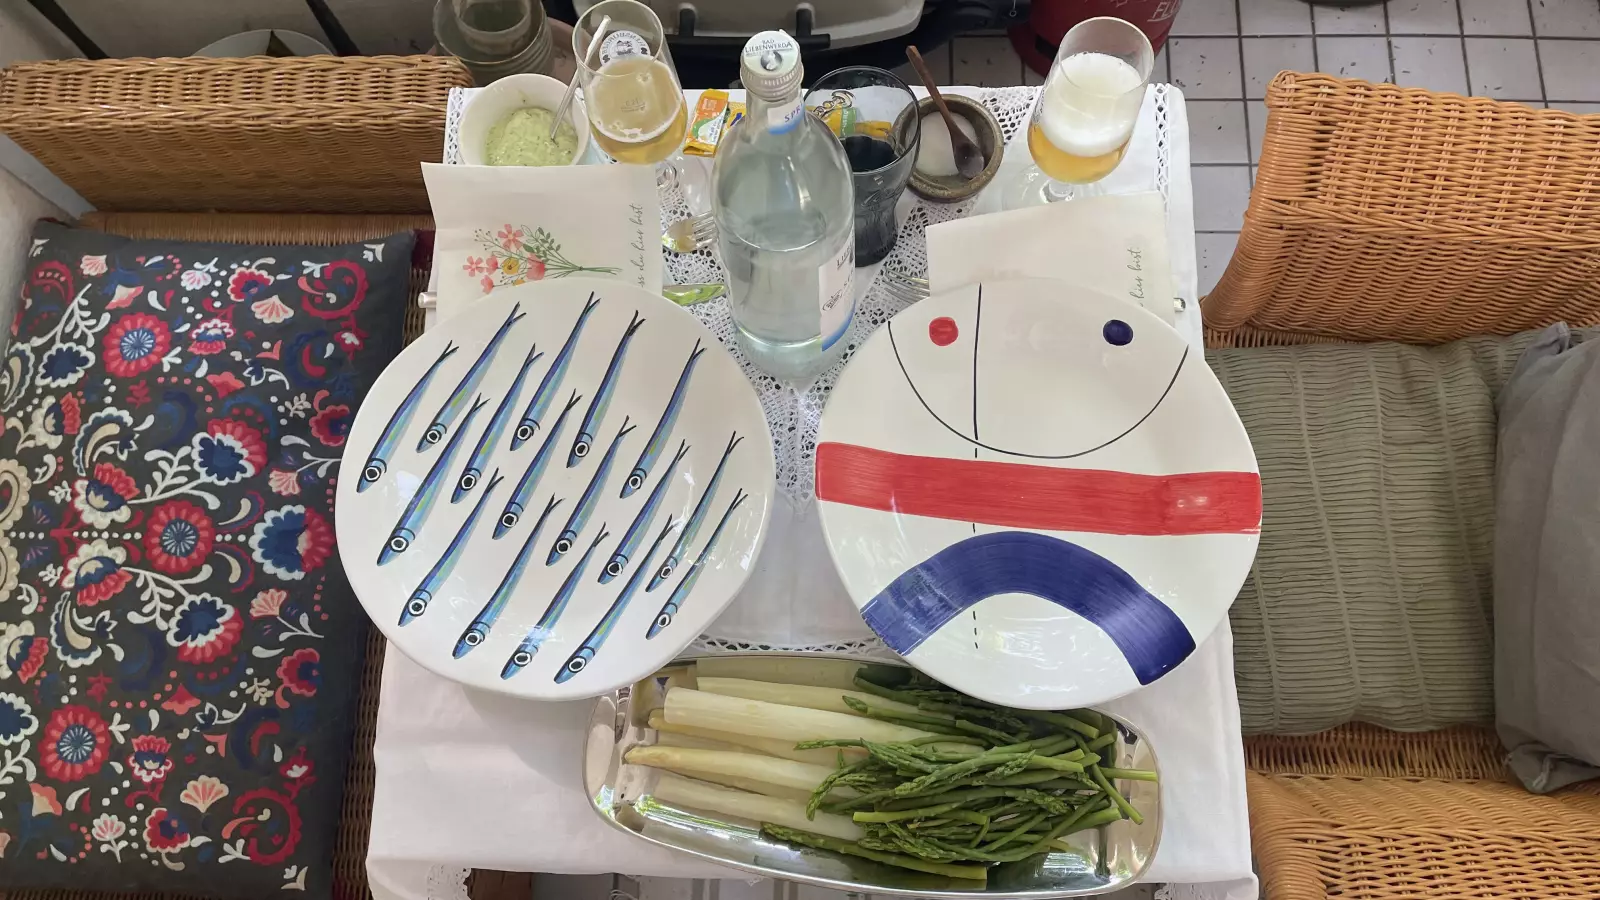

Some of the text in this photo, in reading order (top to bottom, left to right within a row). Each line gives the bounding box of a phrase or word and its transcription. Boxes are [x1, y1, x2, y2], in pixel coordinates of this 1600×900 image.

[744, 41, 793, 53] LIEBENWERDA
[631, 229, 645, 251] hier
[629, 254, 645, 271] du
[1129, 276, 1144, 299] hier
